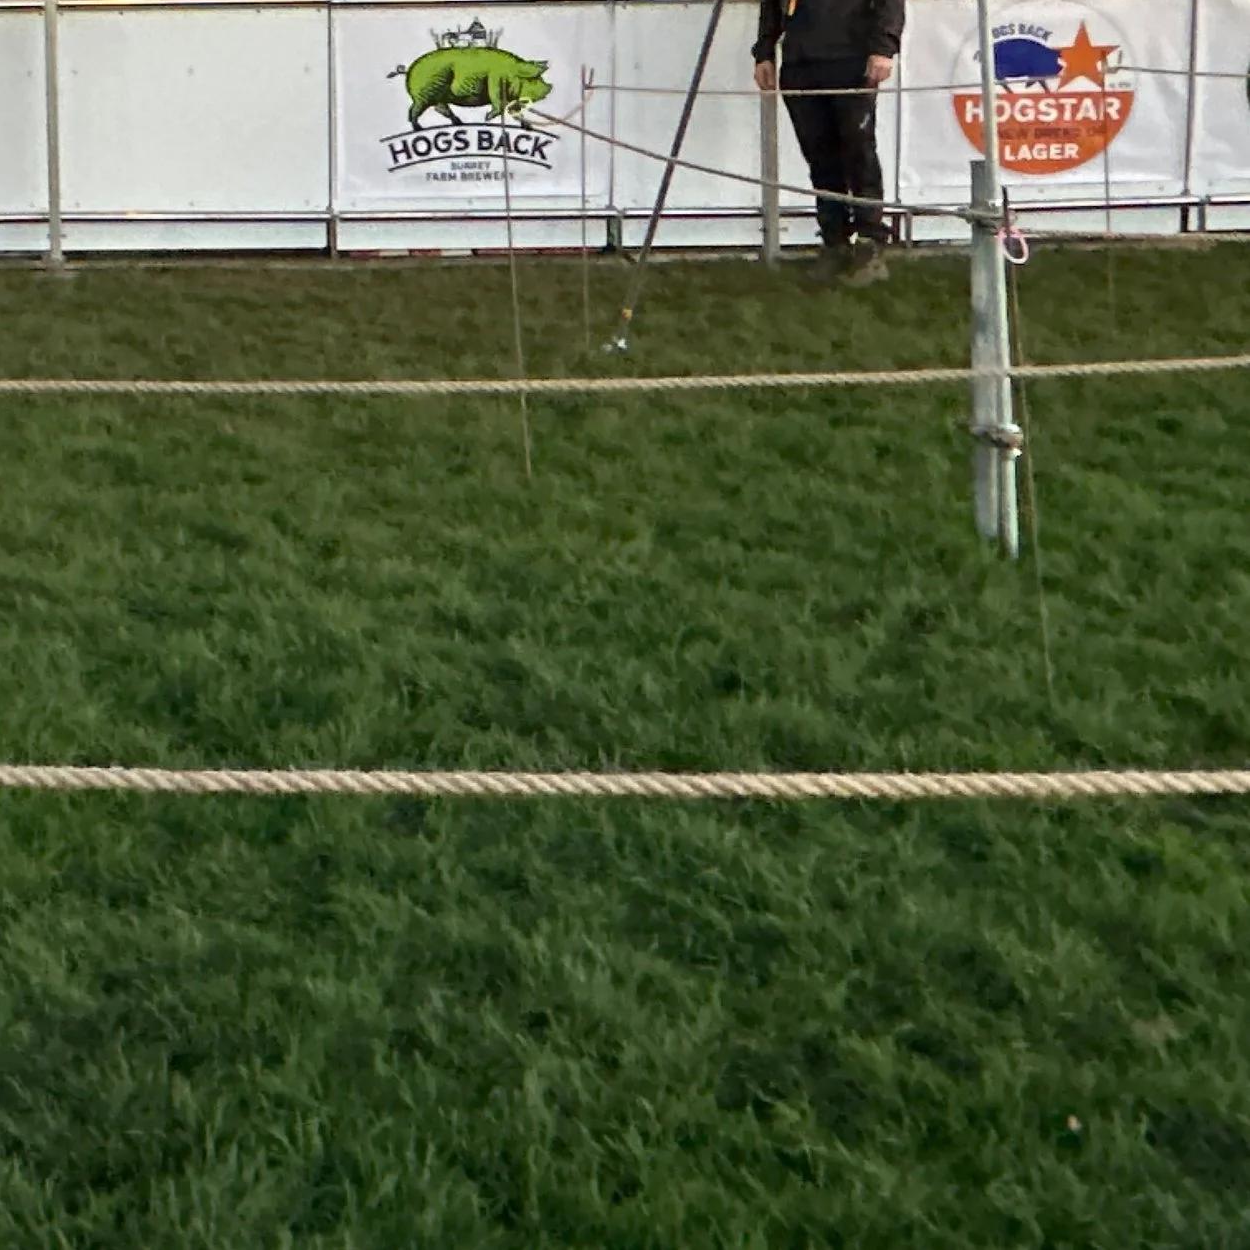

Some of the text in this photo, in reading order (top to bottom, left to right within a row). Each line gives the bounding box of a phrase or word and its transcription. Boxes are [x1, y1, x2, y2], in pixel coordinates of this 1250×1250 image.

[990, 23, 1015, 39] OGS
[388, 130, 553, 165] HOGS BACK
[1004, 143, 1080, 161] LAGER
